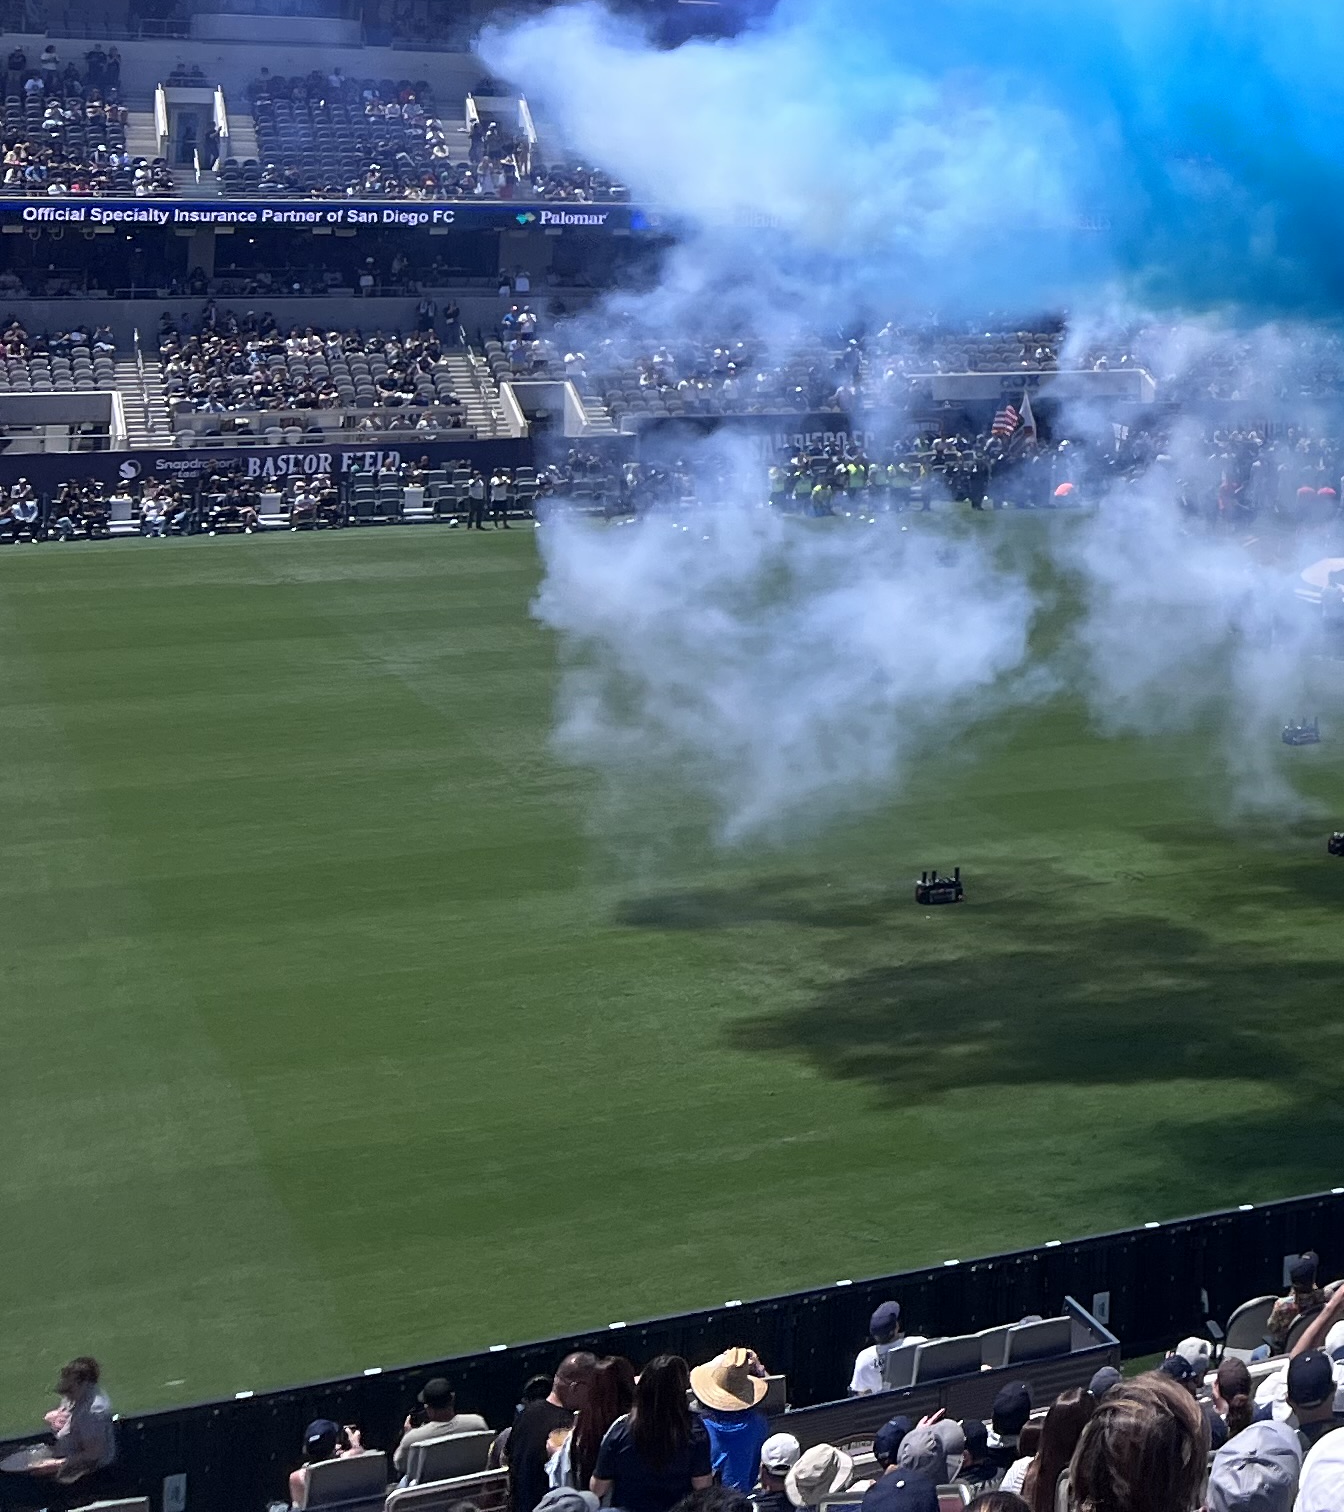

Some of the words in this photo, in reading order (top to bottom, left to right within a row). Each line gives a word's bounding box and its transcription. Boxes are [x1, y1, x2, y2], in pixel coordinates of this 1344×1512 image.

[22, 207, 85, 222] Official
[90, 207, 170, 225] Specialty
[174, 209, 257, 223] Insurance
[261, 209, 323, 223] Partner
[326, 209, 343, 223] of
[347, 210, 379, 224] San
[382, 210, 429, 226] Diego
[432, 210, 455, 224] FC
[538, 211, 608, 225] Palomar
[156, 458, 235, 471] Snapdraon
[340, 450, 401, 473] FELD
